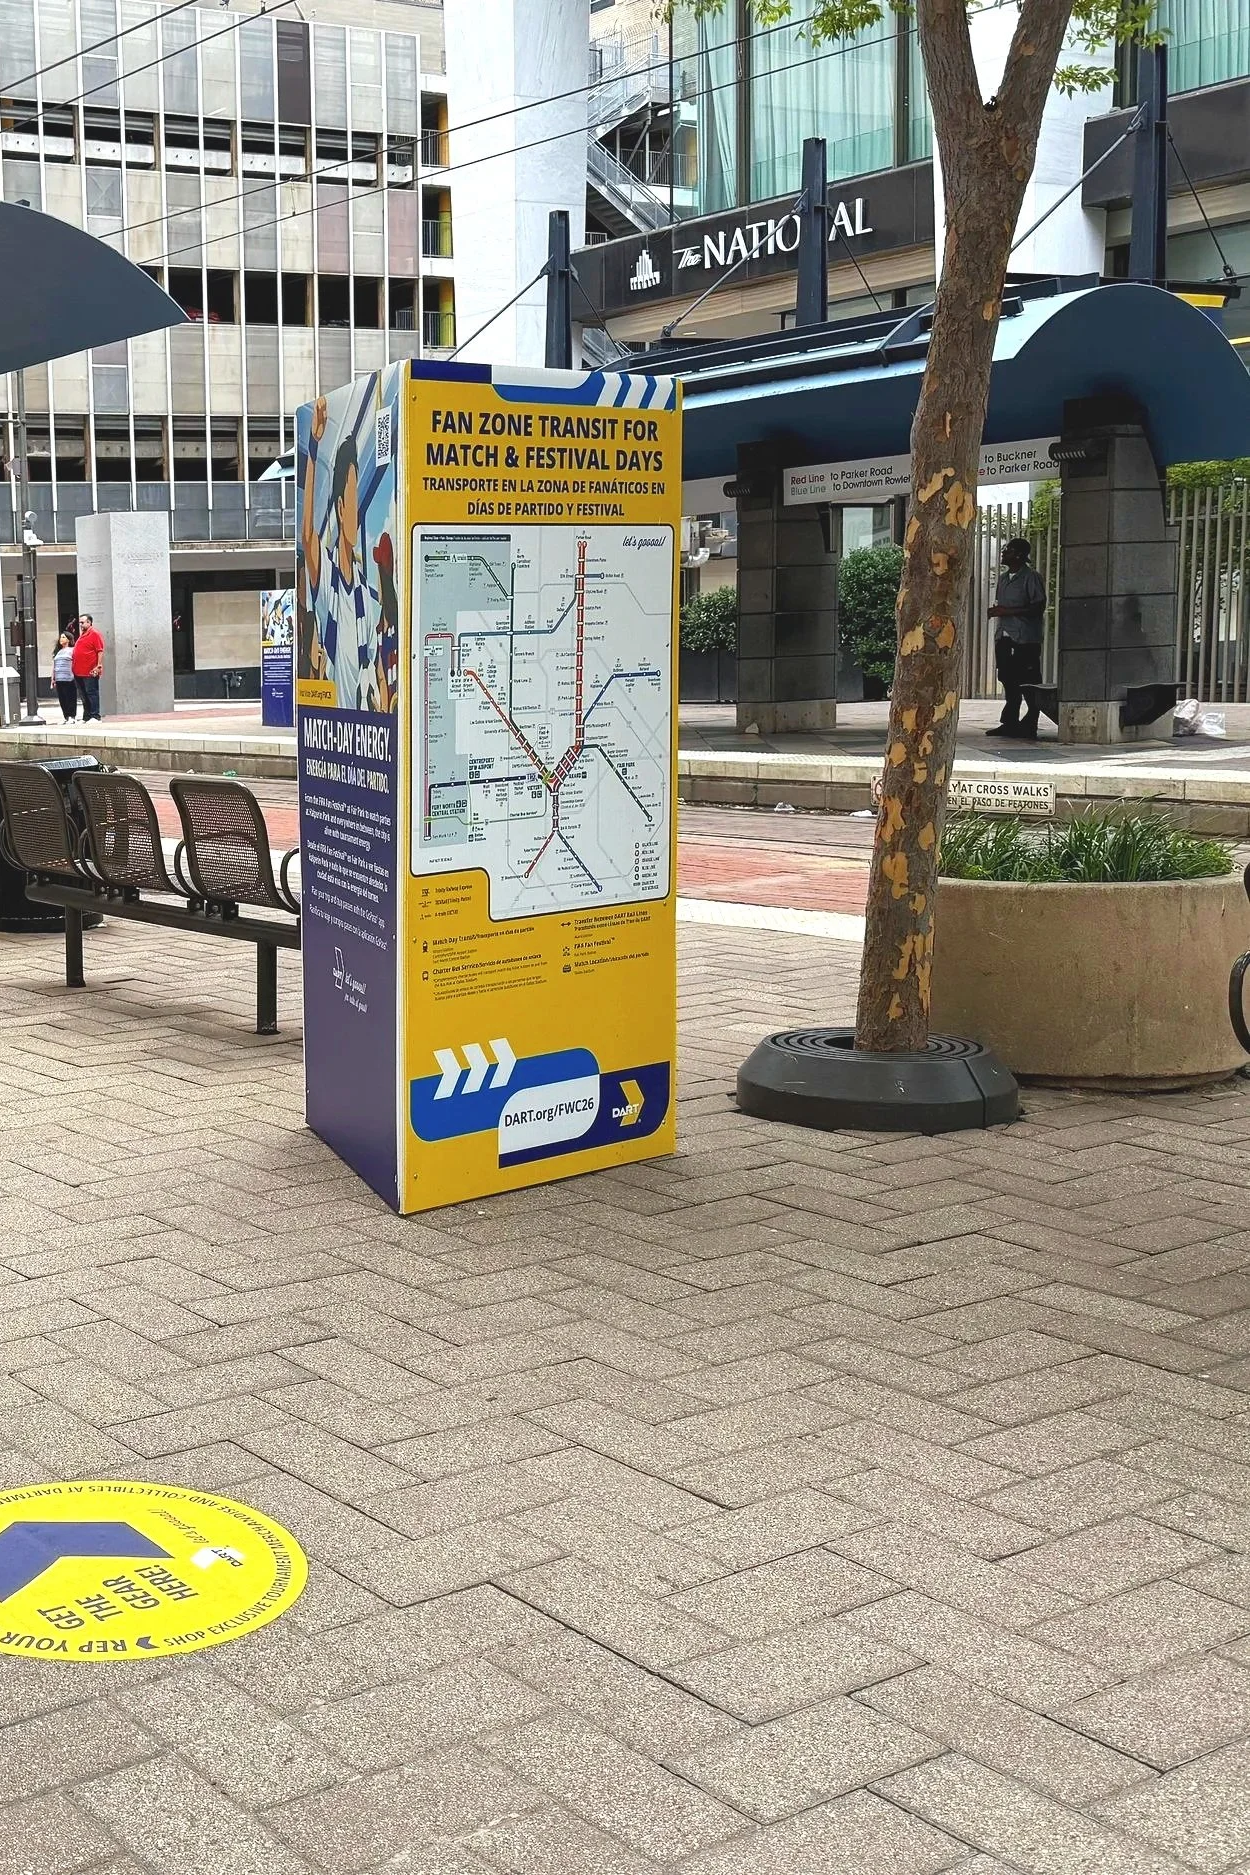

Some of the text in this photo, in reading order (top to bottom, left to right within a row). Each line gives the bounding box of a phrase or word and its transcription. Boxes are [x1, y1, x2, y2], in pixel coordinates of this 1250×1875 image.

[672, 198, 873, 270] The NATIOAL
[432, 410, 659, 441] FAN ZONE TRANSIT FOR
[426, 443, 663, 472] MATCH & FESTIVAL DAYS
[984, 450, 1037, 463] to Buckner
[791, 466, 893, 485] Red Line to Parker Road
[987, 466, 996, 475] to
[999, 462, 1031, 474] Parker
[1033, 460, 1060, 470] Road
[422, 477, 665, 494] TRANSPORTE EN LA ZONA DE FANÁTICOS EN
[791, 486, 808, 495] Blue
[810, 484, 826, 493] Line
[833, 482, 841, 491] to
[843, 478, 883, 490] Downtown
[467, 498, 625, 516] DÍAS DE PARTIDO Y FESTIVAL
[622, 535, 637, 547] let's
[304, 717, 392, 762] MATCH-DAY ENERGY.
[306, 756, 390, 794] ENERGÍA PARA EL DÍA DEL PARTIDO.
[961, 784, 973, 794] AT
[976, 784, 1009, 795] CROSS
[1013, 786, 1049, 797] WALKS
[947, 797, 958, 805] EN
[961, 798, 969, 806] EL
[973, 798, 992, 807] PASO
[995, 799, 1005, 807] DE
[504, 1097, 639, 1127] DART.org/FWC26 DART
[89, 1485, 186, 1499] COLLECTIBLES
[189, 1495, 220, 1507] AND
[217, 1505, 285, 1550] MERCHANDISE
[211, 1549, 244, 1568] DART
[134, 1565, 200, 1601] HERE!
[262, 1550, 292, 1601] TOURNAMENT
[102, 1575, 160, 1609] GEAR
[36, 1605, 85, 1630] GET
[75, 1593, 123, 1622] THE
[207, 1599, 272, 1635] EXCLUSIVE
[0, 1631, 68, 1652] YOUR
[78, 1639, 127, 1653] REP
[163, 1630, 206, 1647] SHOP
